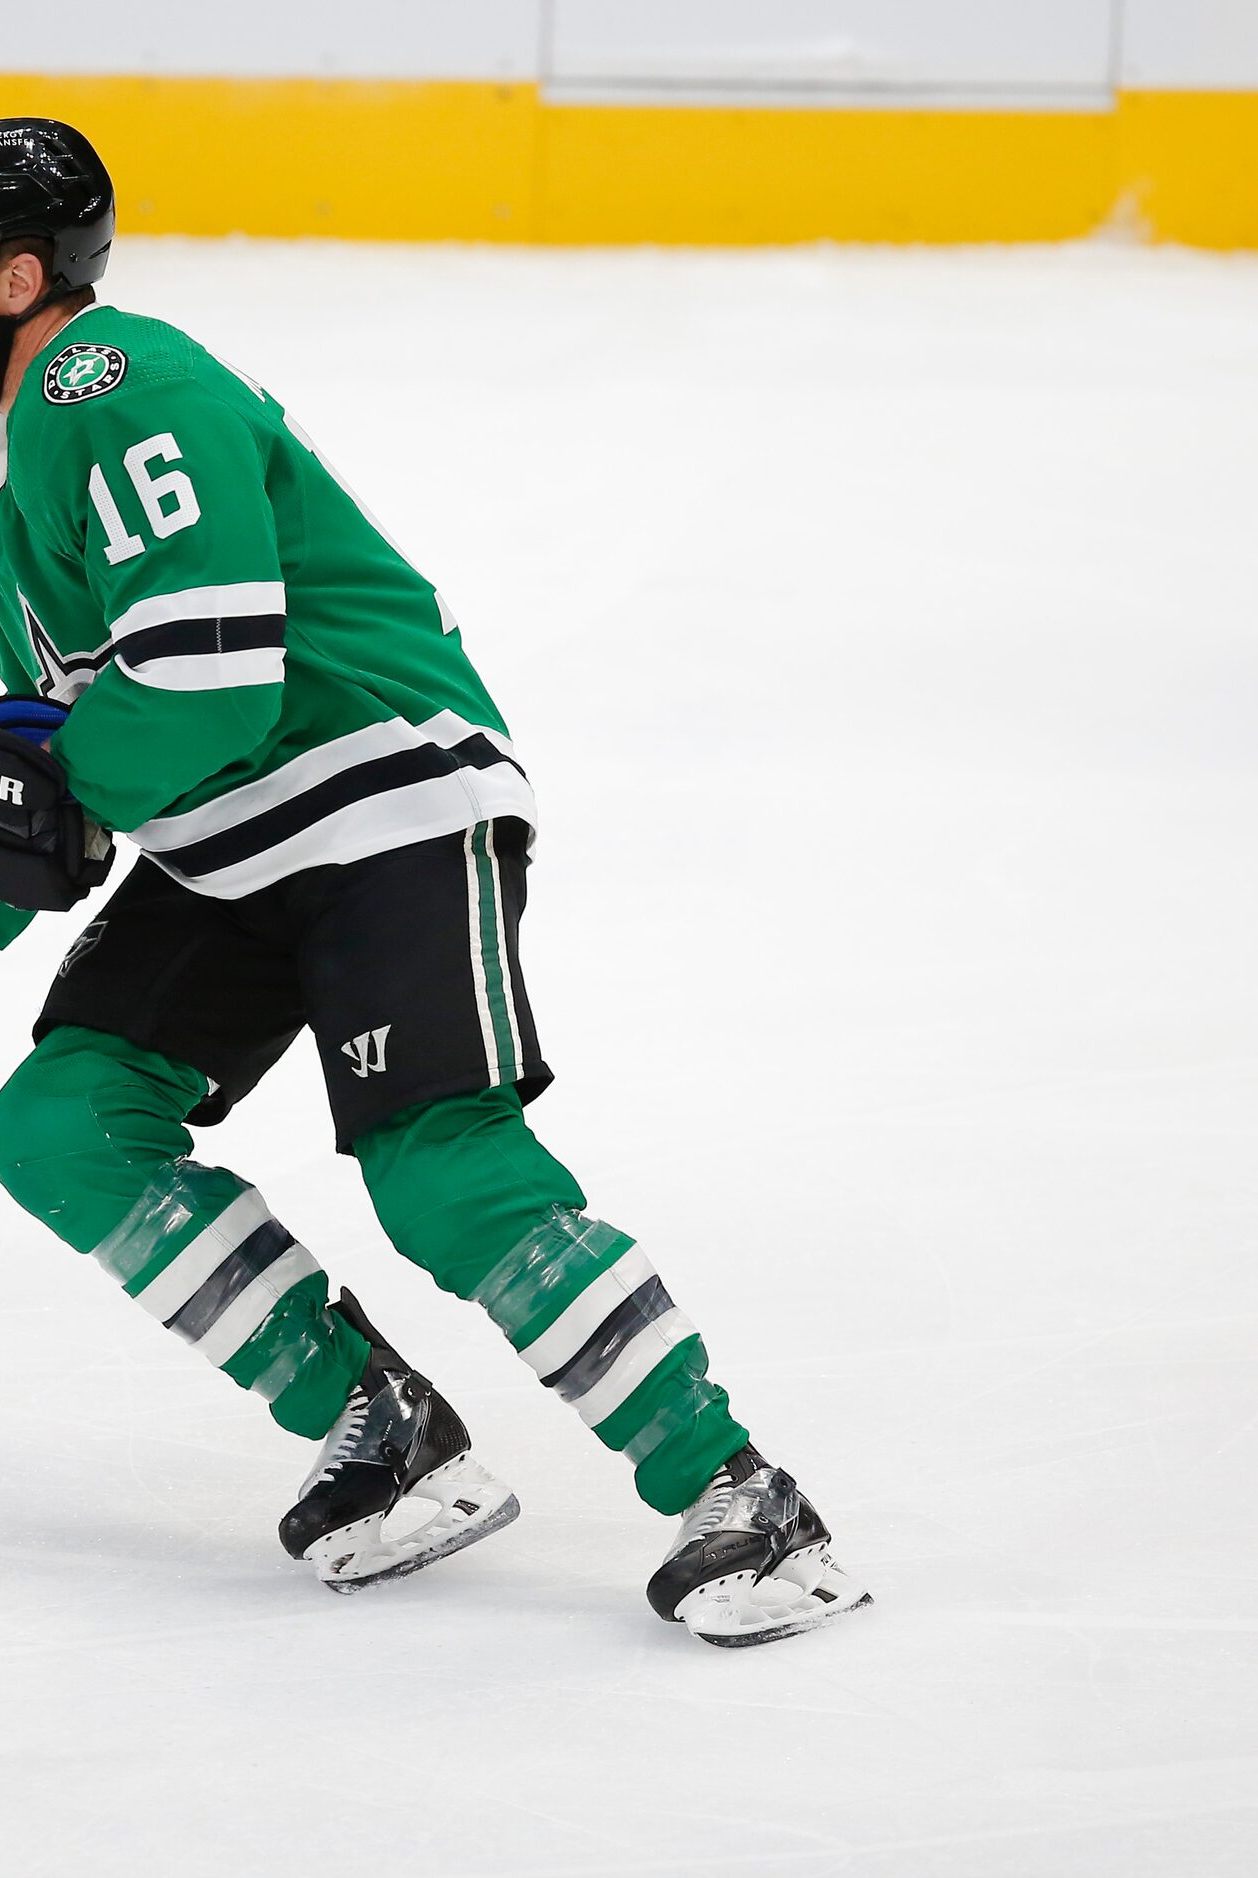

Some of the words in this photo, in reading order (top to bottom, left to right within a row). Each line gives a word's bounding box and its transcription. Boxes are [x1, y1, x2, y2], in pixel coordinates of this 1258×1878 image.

[48, 347, 112, 390] DALLAS
[60, 362, 120, 399] STARS
[87, 432, 201, 566] 16
